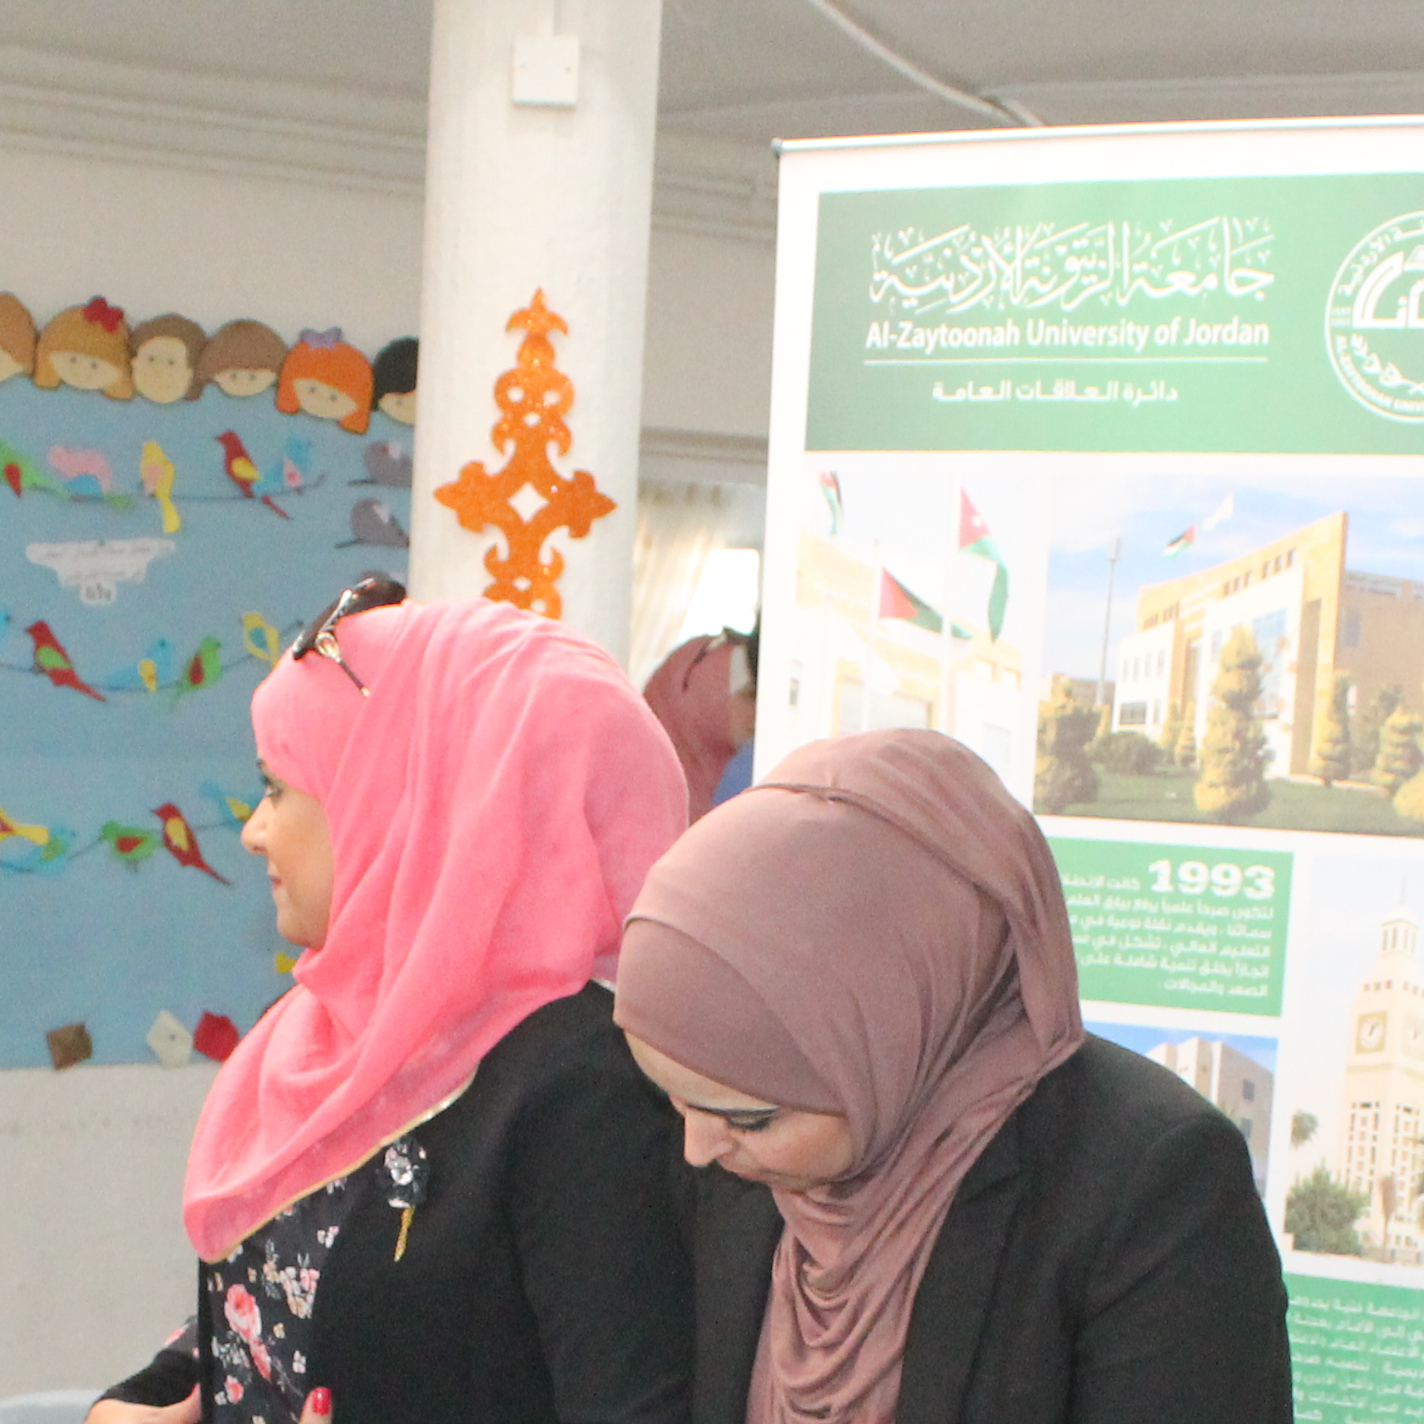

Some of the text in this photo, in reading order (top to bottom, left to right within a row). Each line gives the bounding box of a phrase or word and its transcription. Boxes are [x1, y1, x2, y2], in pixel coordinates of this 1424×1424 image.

[865, 314, 1270, 354] Al-Zaytoonah University of Jordan
[932, 378, 1180, 406] دائرة العلاقات العامة
[1147, 858, 1276, 899] 1993
